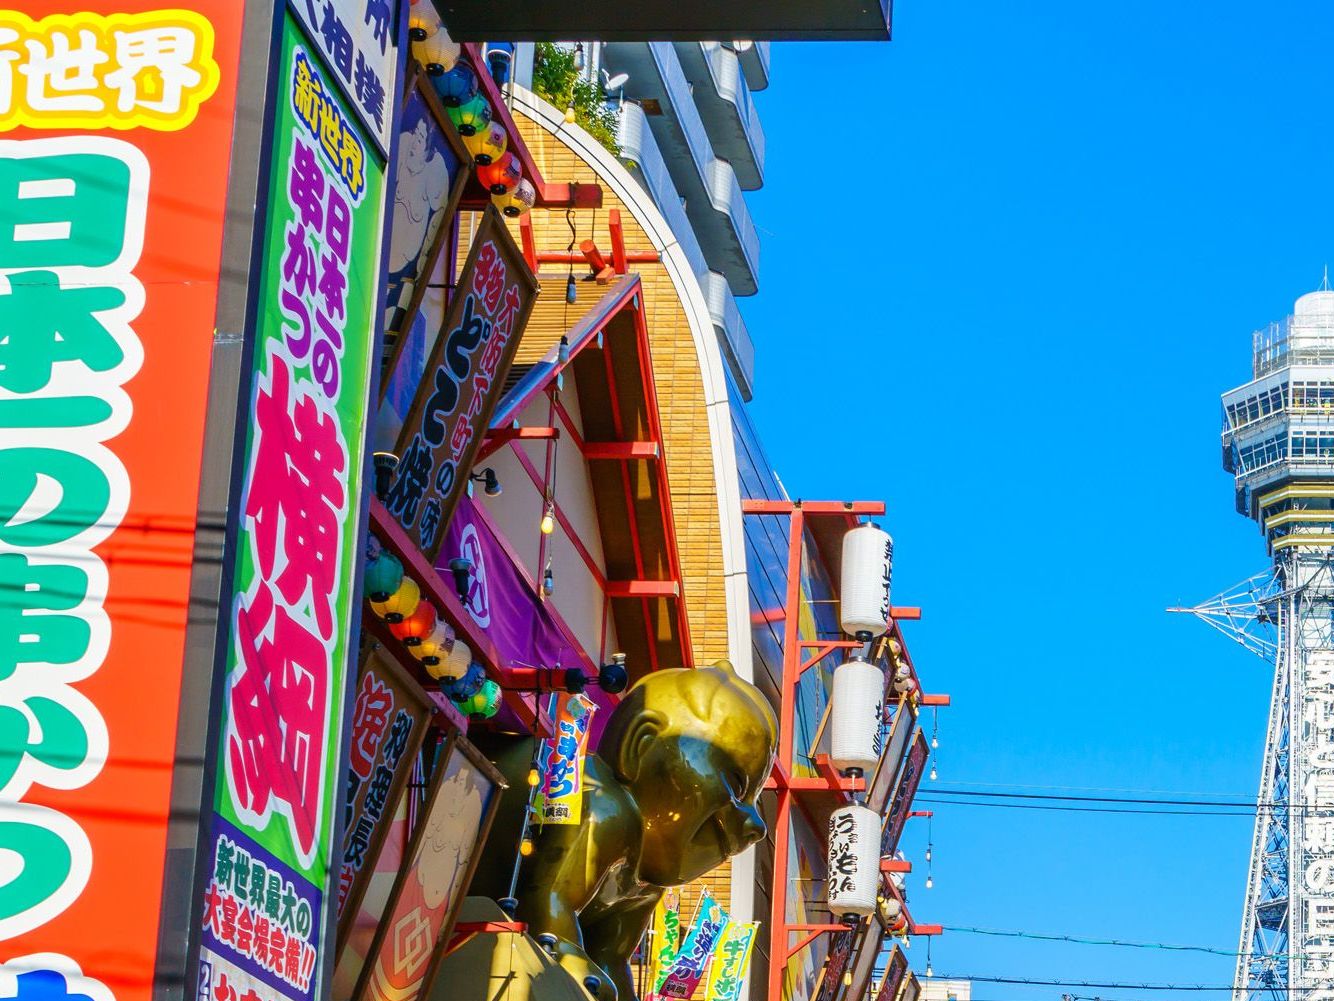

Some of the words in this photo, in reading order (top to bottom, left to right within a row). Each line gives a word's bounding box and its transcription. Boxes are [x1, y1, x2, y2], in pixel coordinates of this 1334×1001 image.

[0, 27, 202, 114] 世界
[292, 54, 365, 199] 新世界
[305, 0, 387, 134] 相撲
[283, 137, 325, 360] 串かつ
[312, 185, 351, 398] 日本一の
[229, 355, 347, 858] 横綱
[203, 884, 316, 993] 大宴会場完備!!
[216, 838, 312, 939] 新世界最大の
